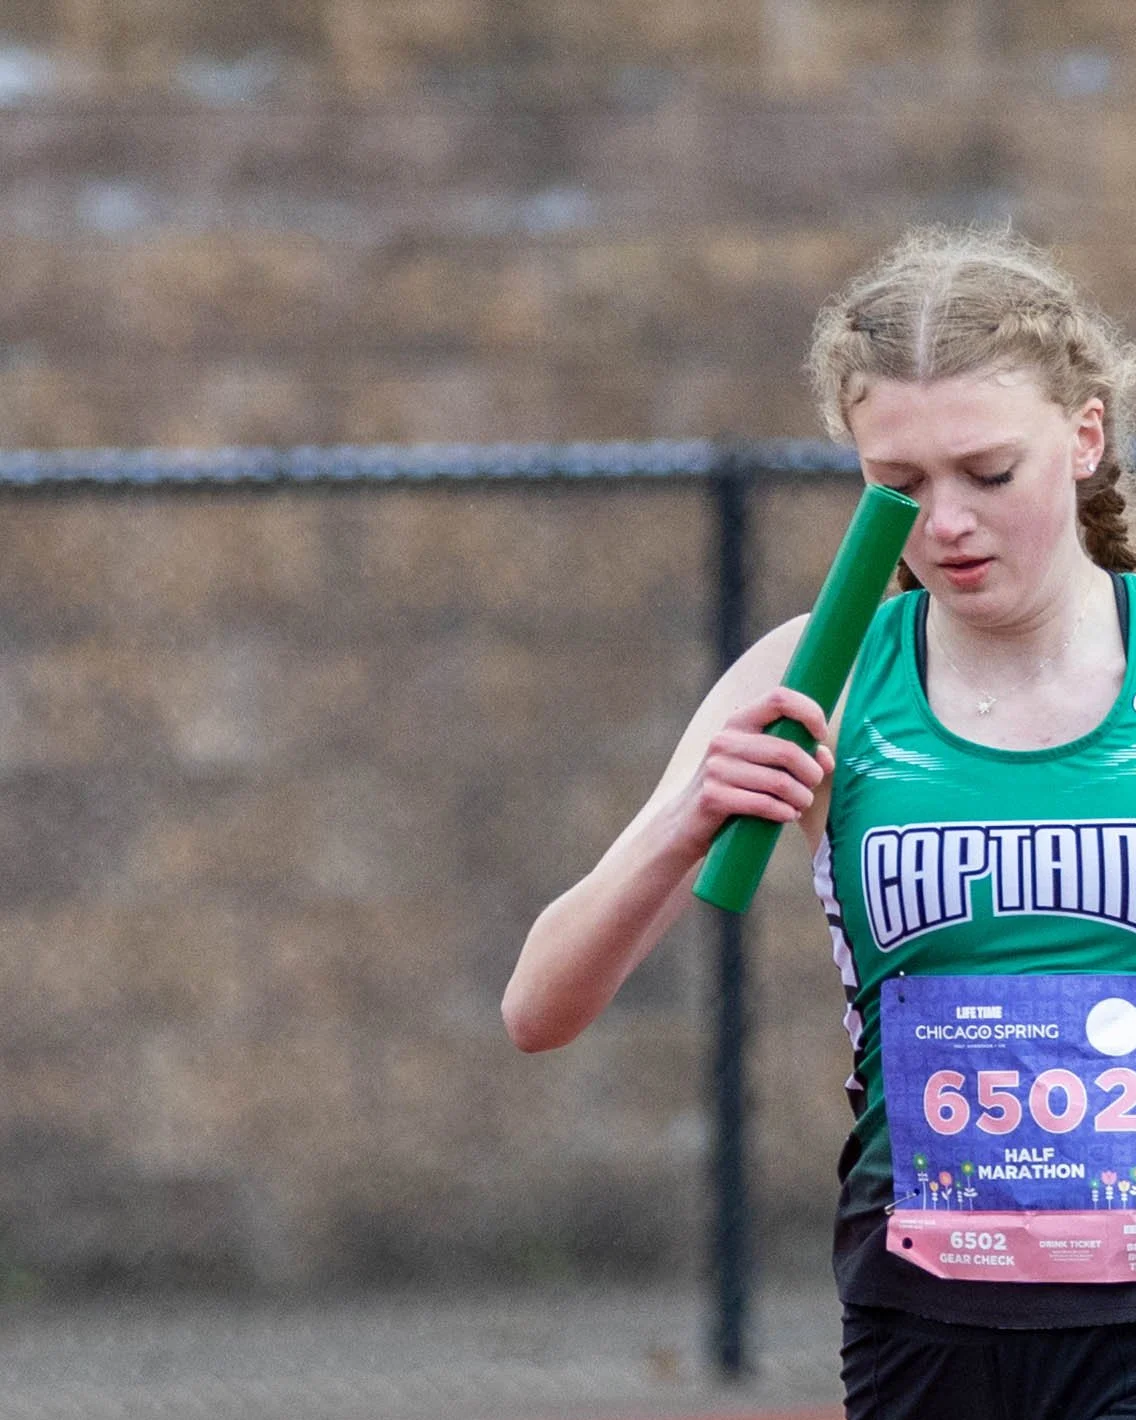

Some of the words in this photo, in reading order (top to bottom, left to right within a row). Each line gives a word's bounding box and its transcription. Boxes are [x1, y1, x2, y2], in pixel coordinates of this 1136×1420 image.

[915, 1025, 992, 1040] CHICAGO
[994, 1024, 1059, 1039] SPRING
[1005, 1148, 1055, 1163] HALF
[978, 1164, 1085, 1180] MARATHON
[950, 1231, 1007, 1250] 6502
[1039, 1240, 1068, 1249] DRINK
[1070, 1240, 1102, 1249] TICKET
[940, 1253, 971, 1264] GEAR
[973, 1255, 1015, 1266] CHECK
